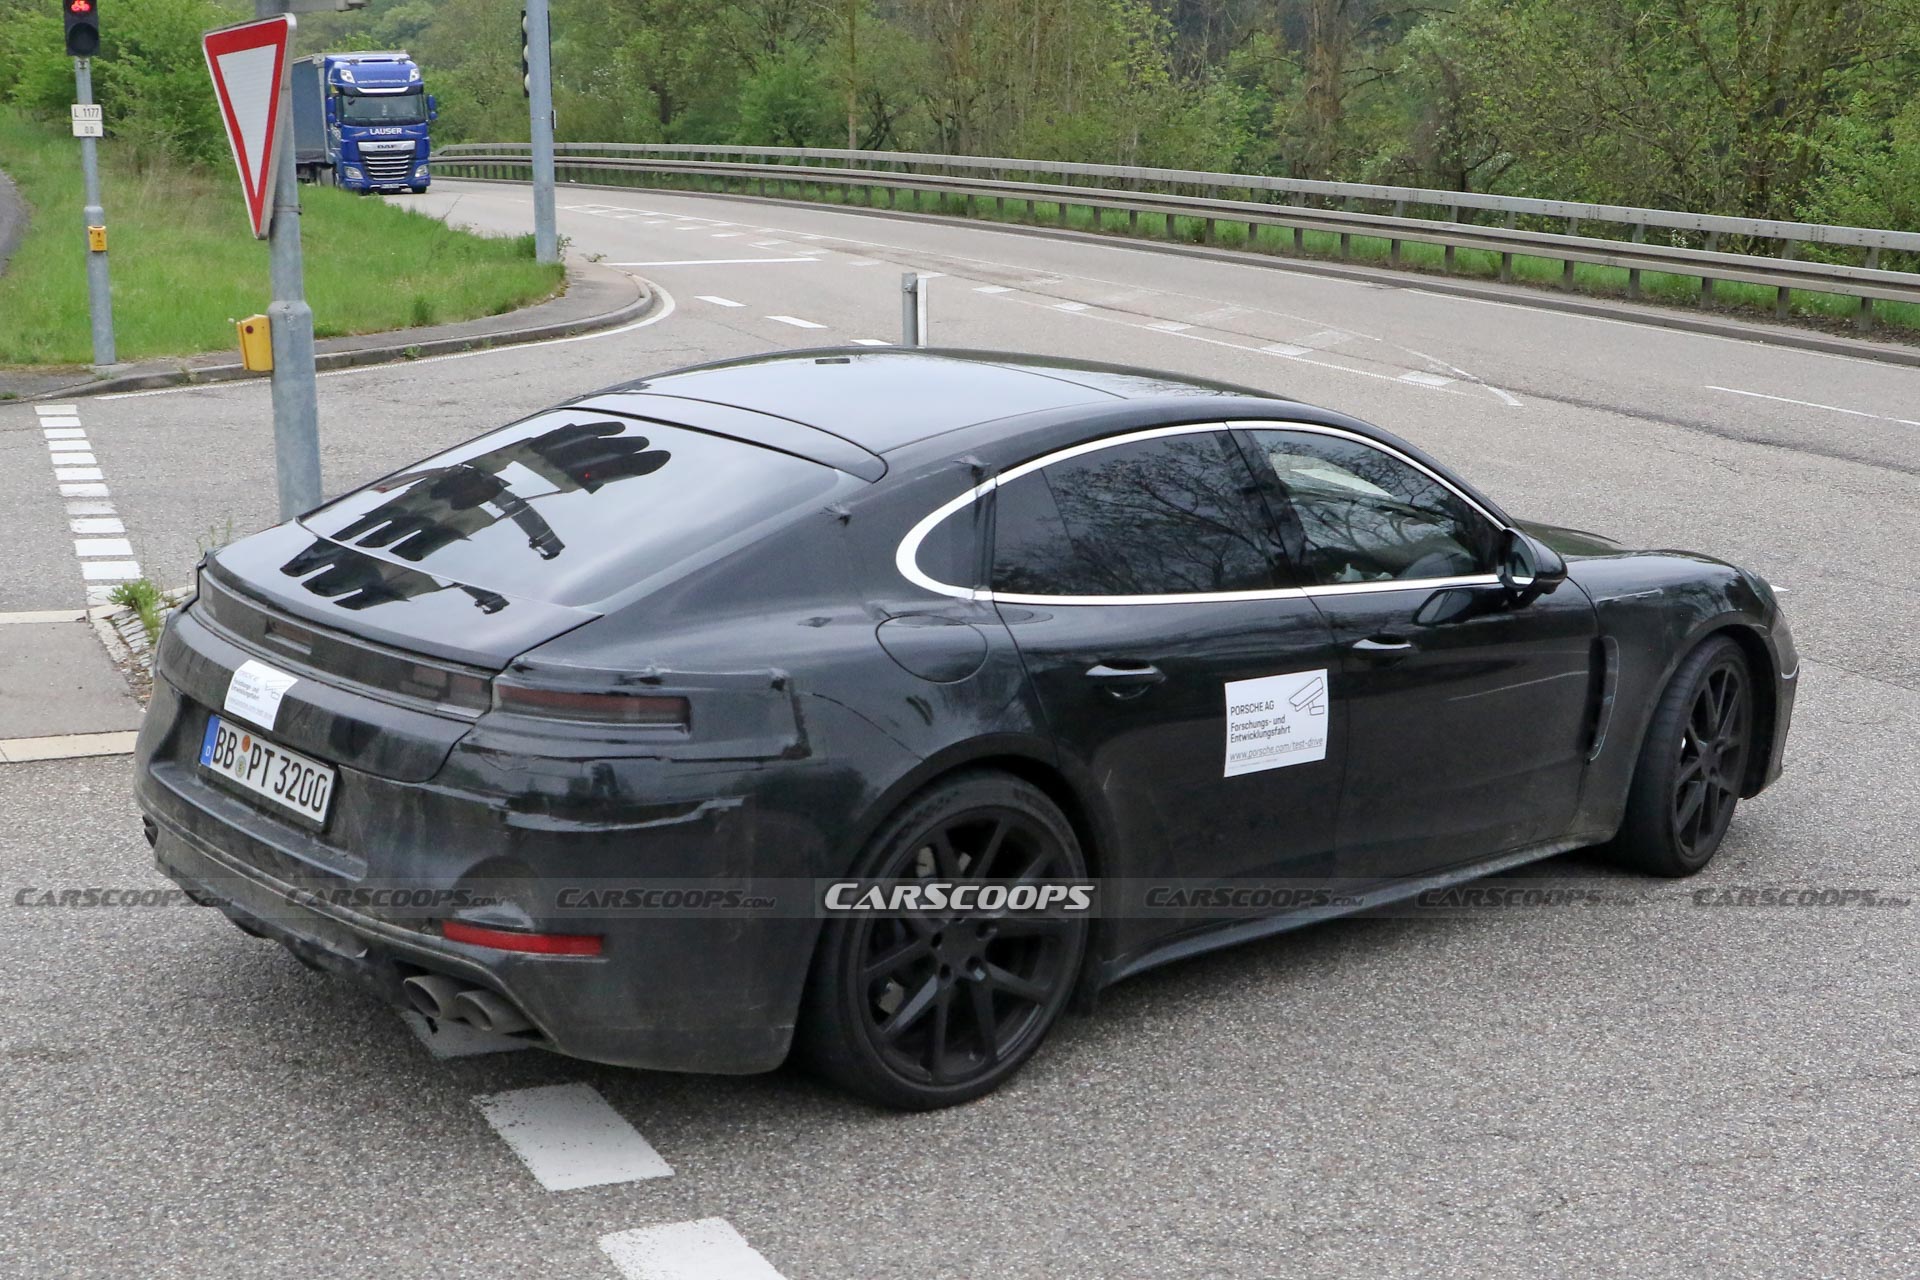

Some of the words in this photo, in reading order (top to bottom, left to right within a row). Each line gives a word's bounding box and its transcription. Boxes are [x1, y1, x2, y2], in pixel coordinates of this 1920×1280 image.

[74, 107, 79, 118] L
[83, 107, 100, 118] 1177
[369, 127, 403, 135] LAUSER
[1230, 702, 1264, 716] PORSCHE
[1265, 700, 1275, 711] AG
[1230, 718, 1272, 732] Forschungs-
[1273, 714, 1286, 725] und
[1230, 725, 1291, 743] Entwicklungsfahrt
[1229, 737, 1324, 760] www.porsche.com/test-drive
[212, 726, 238, 770] BB
[246, 742, 276, 788] PT
[273, 755, 328, 813] 3200
